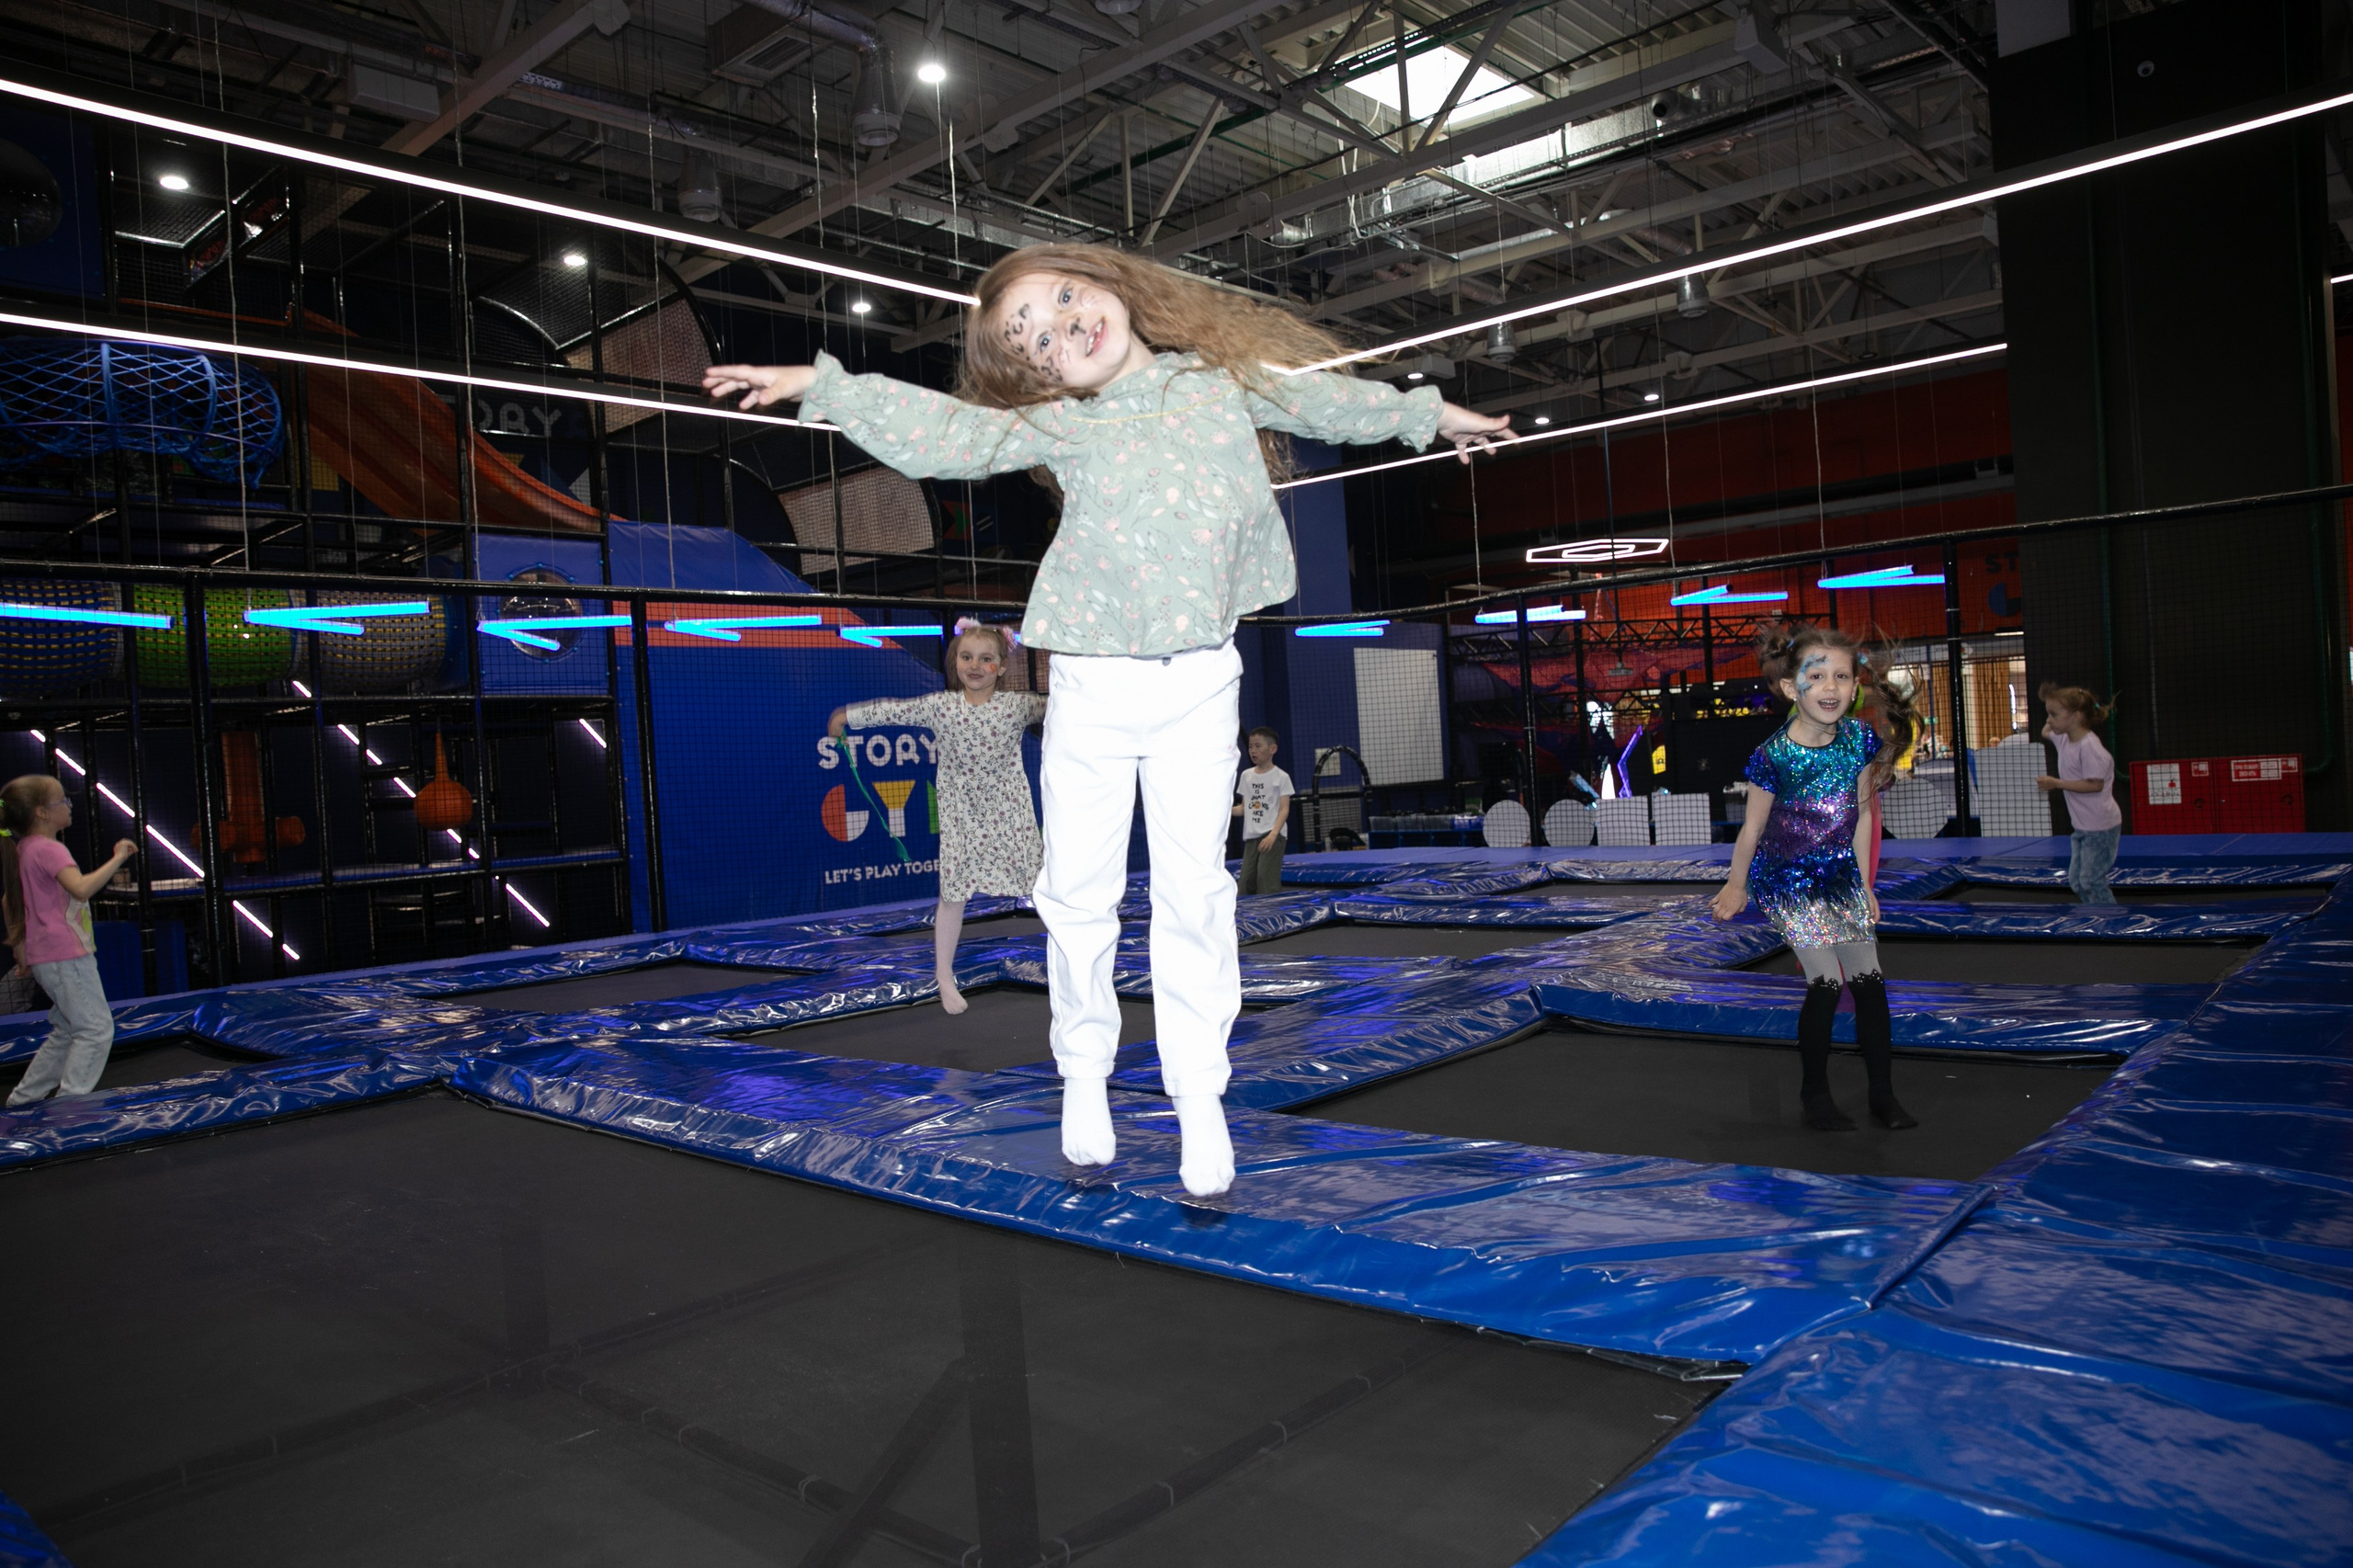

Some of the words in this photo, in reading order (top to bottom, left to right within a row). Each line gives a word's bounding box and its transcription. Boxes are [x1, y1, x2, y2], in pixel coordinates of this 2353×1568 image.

[817, 733, 938, 769] STORY
[824, 868, 862, 884] LET'S
[866, 863, 901, 880] PLAY
